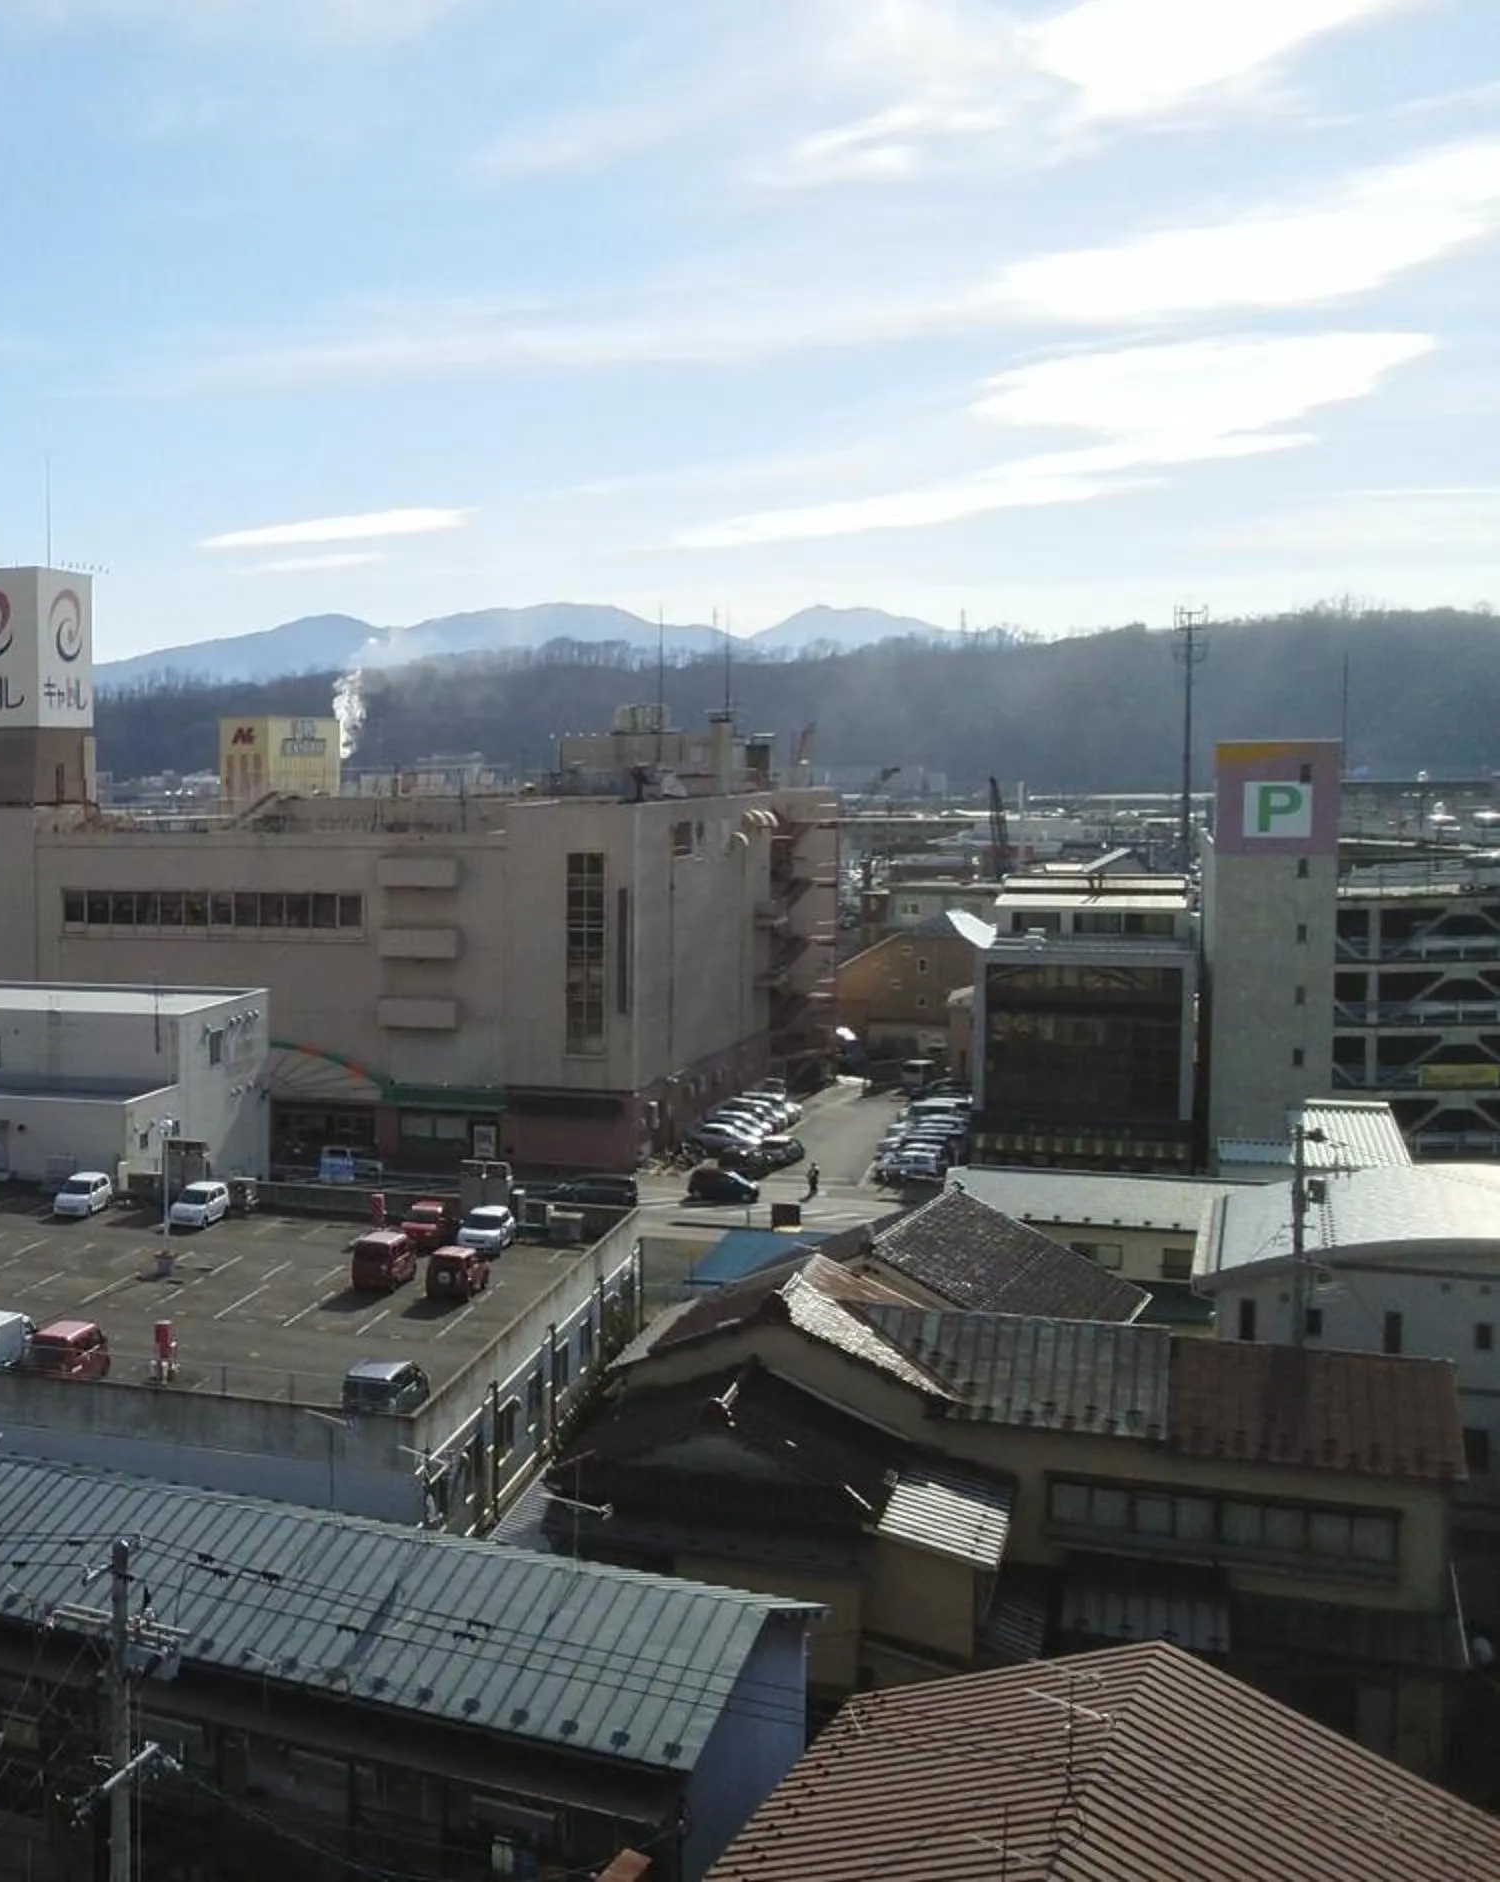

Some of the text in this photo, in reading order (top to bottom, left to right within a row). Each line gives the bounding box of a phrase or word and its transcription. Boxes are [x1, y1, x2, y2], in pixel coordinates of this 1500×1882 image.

[43, 675, 88, 710] キャトル
[1258, 785, 1303, 832] P
